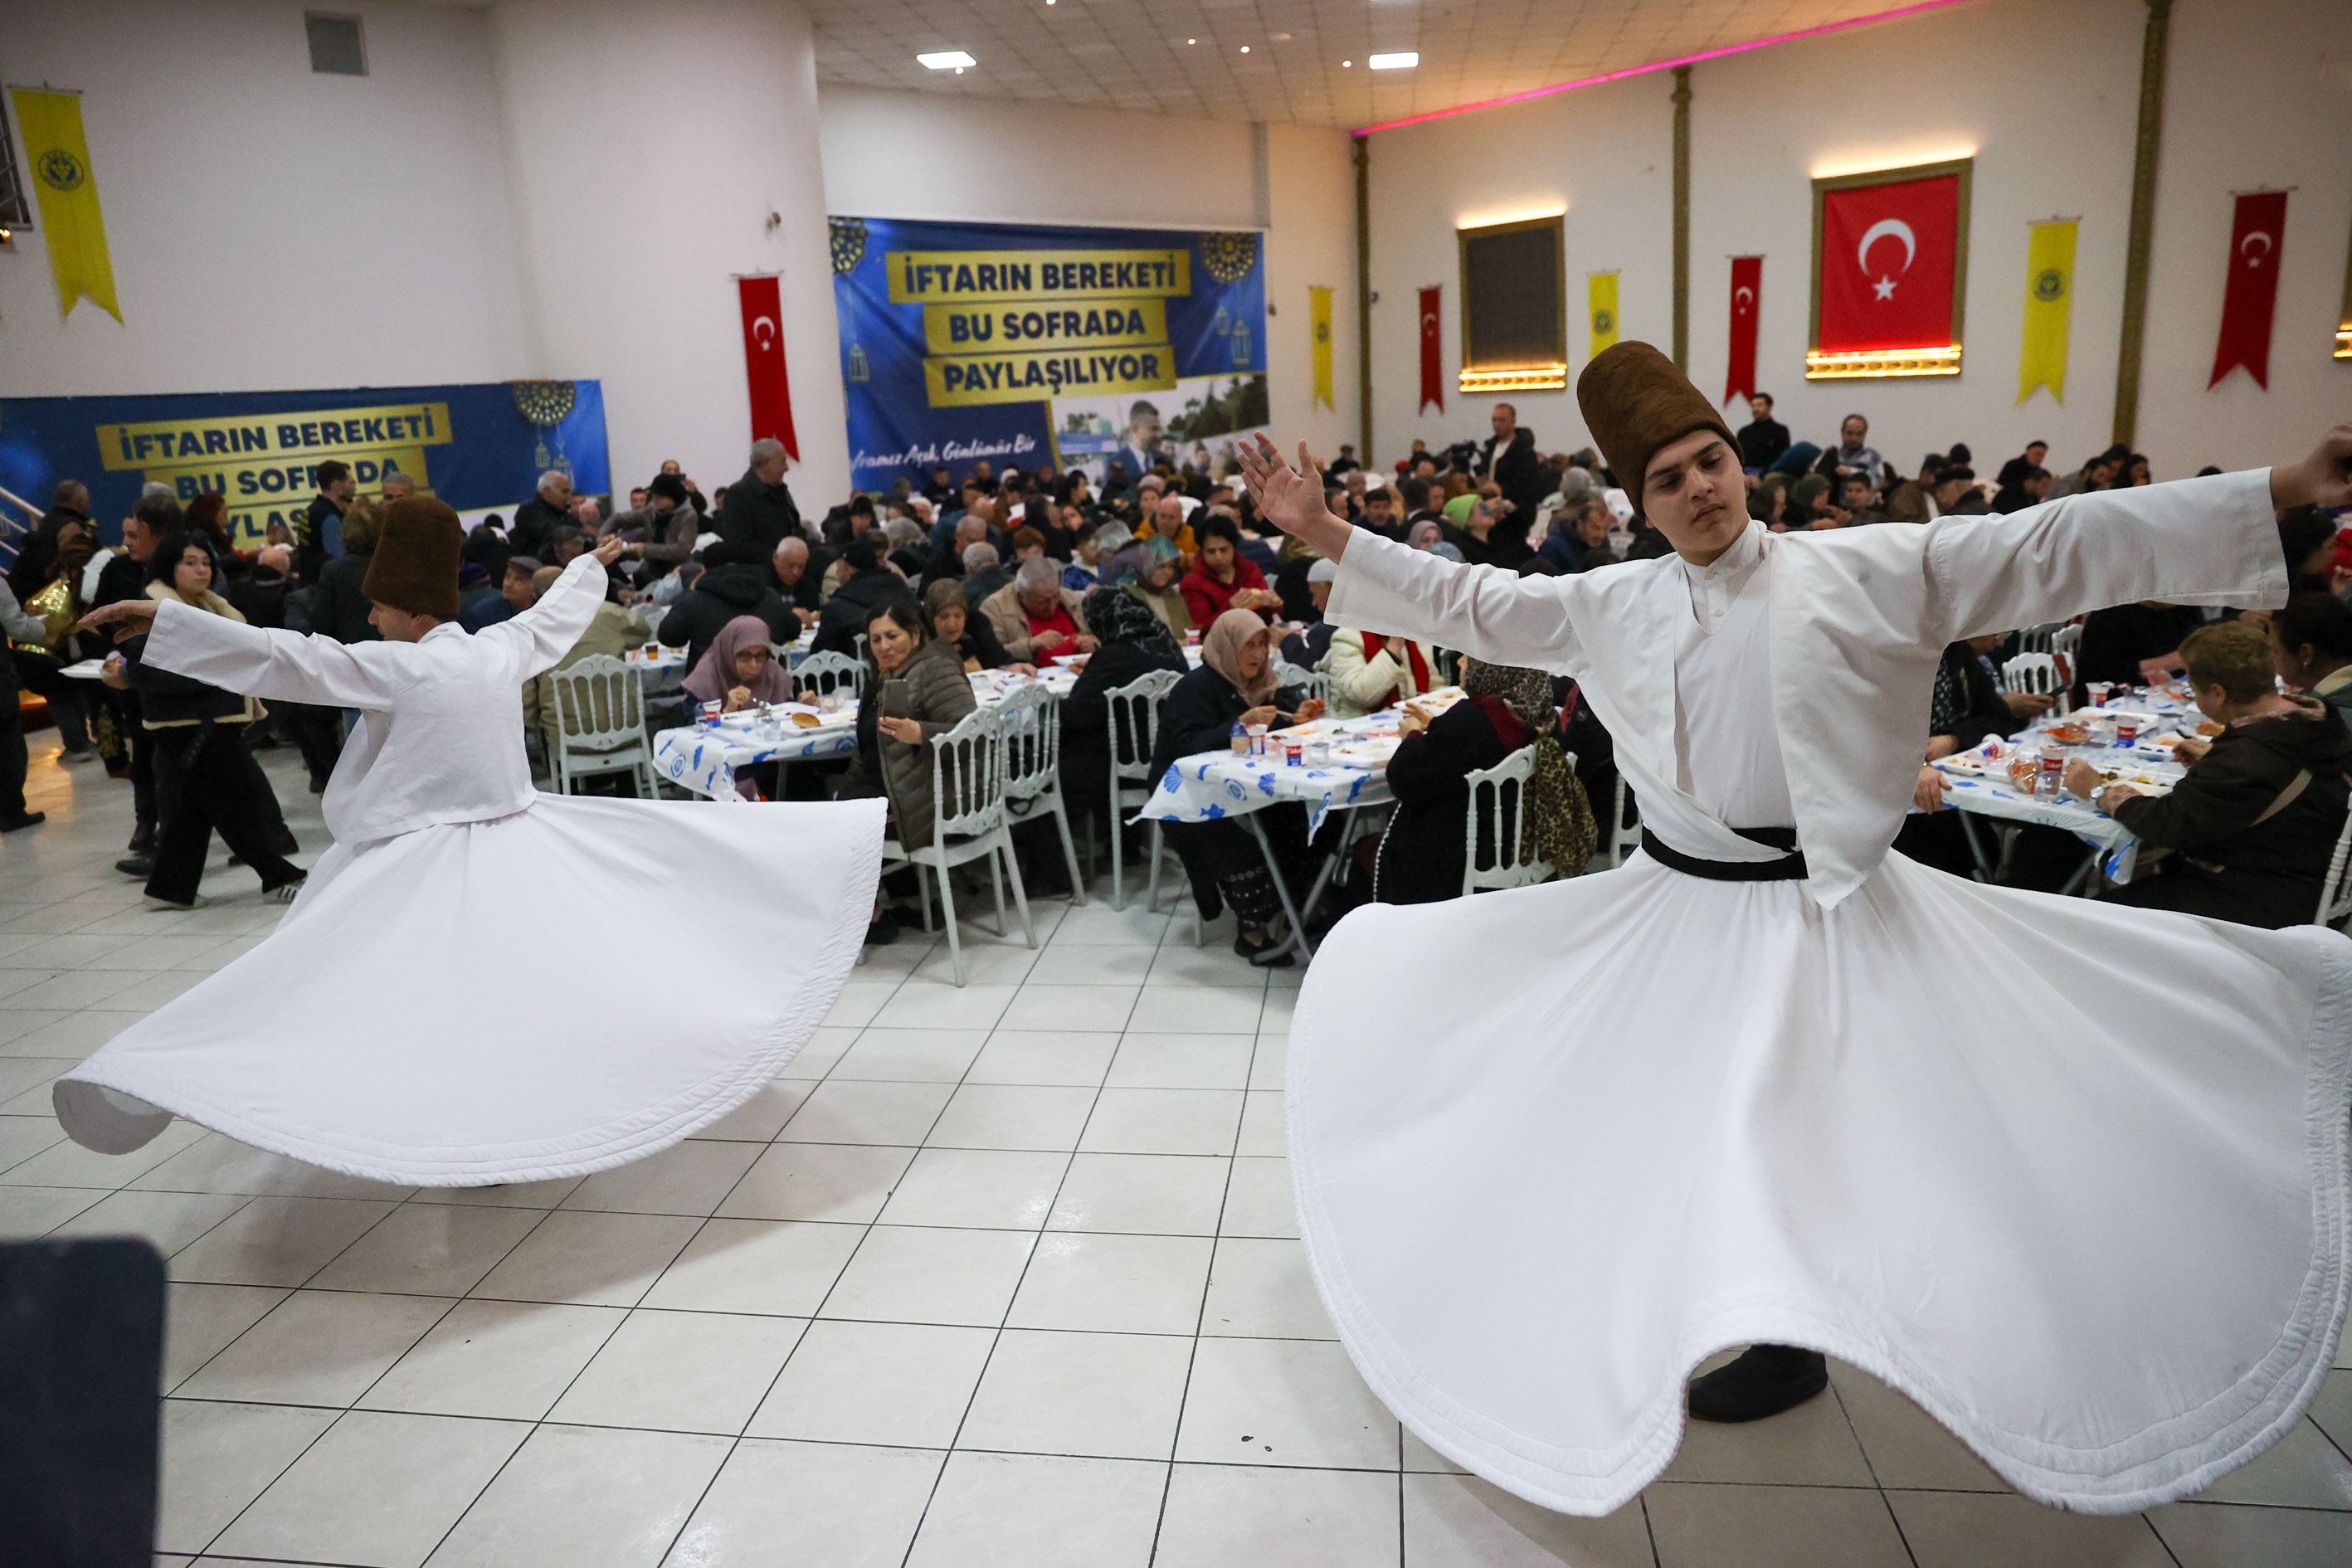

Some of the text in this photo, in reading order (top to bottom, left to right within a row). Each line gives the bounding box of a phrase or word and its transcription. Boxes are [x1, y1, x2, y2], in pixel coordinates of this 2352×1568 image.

[905, 254, 1176, 294] İFTARIN BEREKETİ
[949, 309, 1146, 342] BU SOFRADA
[943, 353, 1160, 394] PAYLAŞILIYOR
[119, 407, 435, 461] İFTARIN BEREKETİ
[175, 458, 401, 500] BU SOFDA
